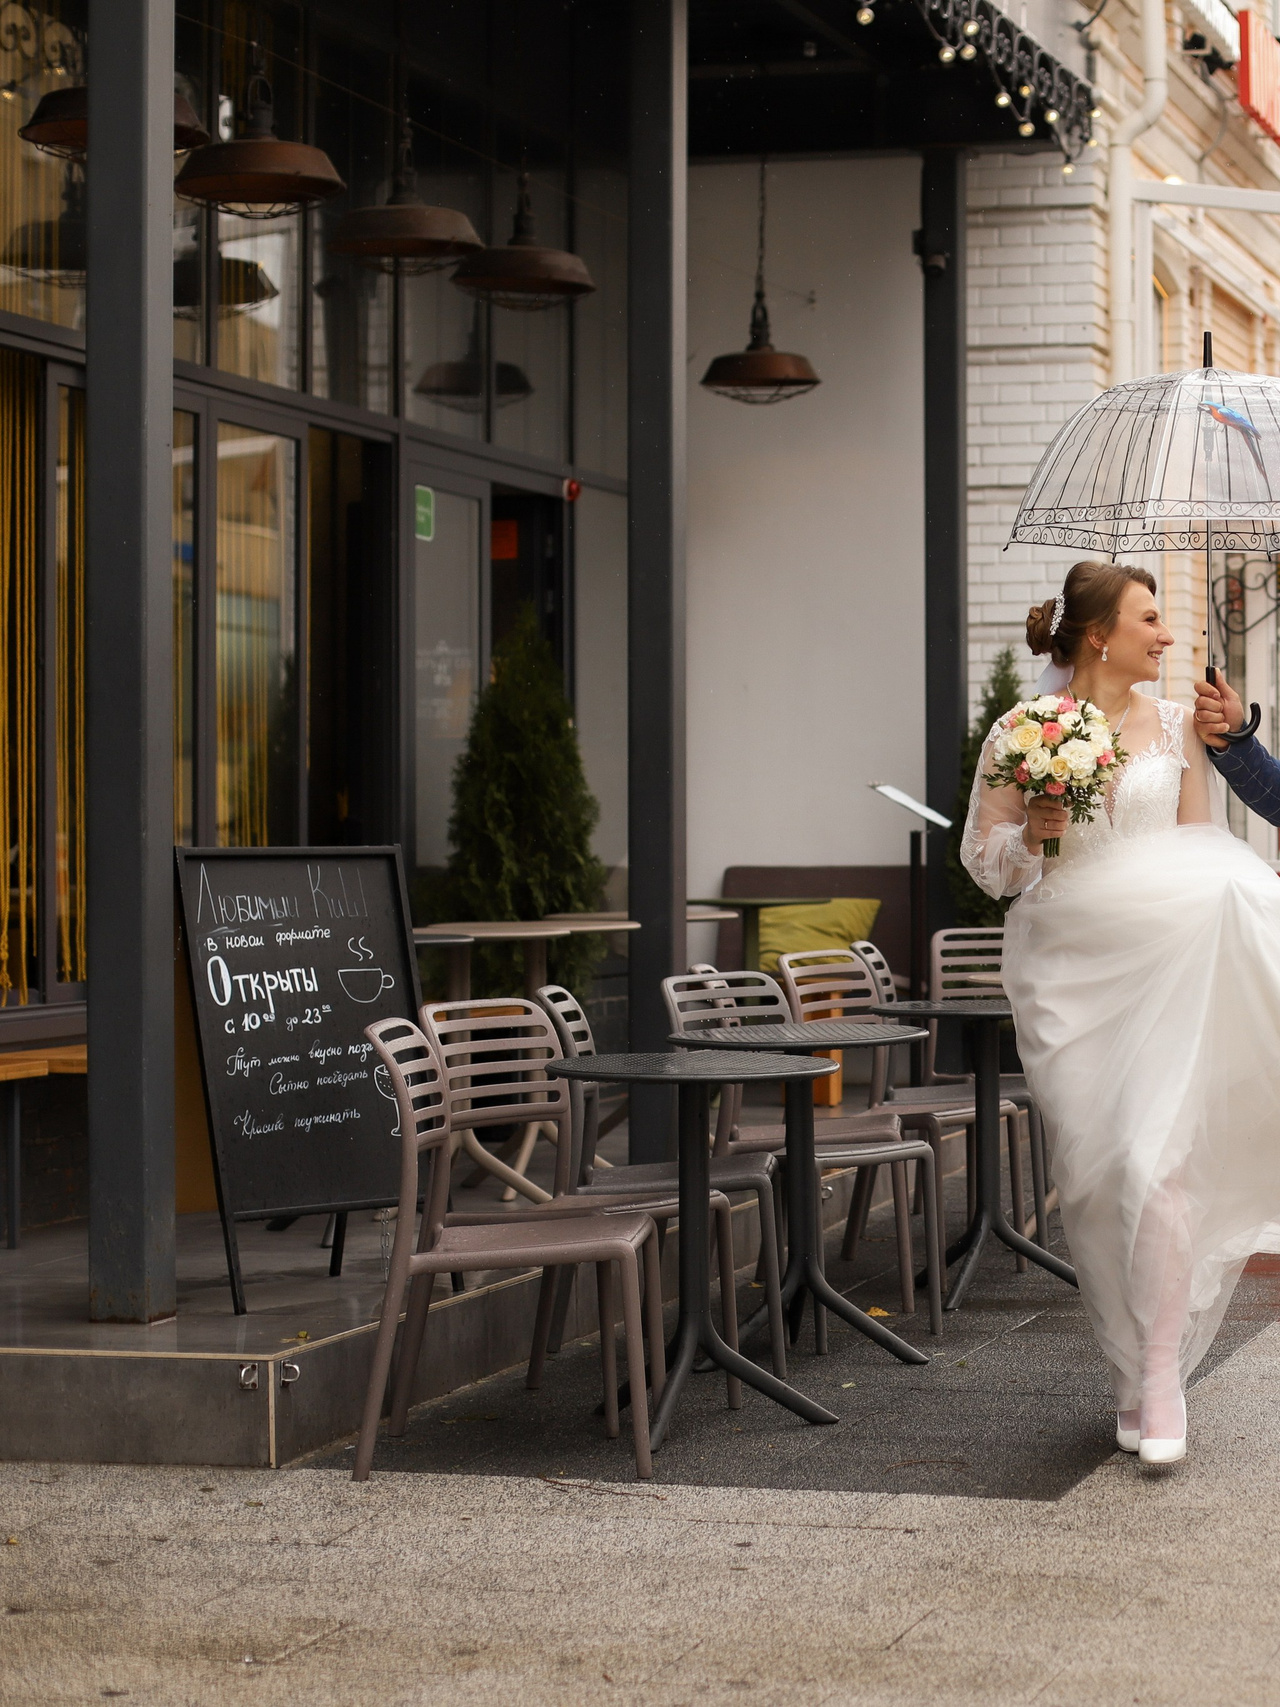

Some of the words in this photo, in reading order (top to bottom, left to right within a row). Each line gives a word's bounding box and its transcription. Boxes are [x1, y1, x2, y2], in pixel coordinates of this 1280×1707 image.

[276, 925, 331, 946] формате
[286, 1016, 299, 1032] до
[226, 1046, 261, 1078] Тут
[267, 1055, 300, 1066] можно
[308, 1039, 343, 1065] вкусно
[269, 1072, 310, 1096] Сытно
[316, 1069, 369, 1088] пообедать
[233, 1109, 285, 1140] Красиво
[294, 1107, 361, 1133] поужинать
